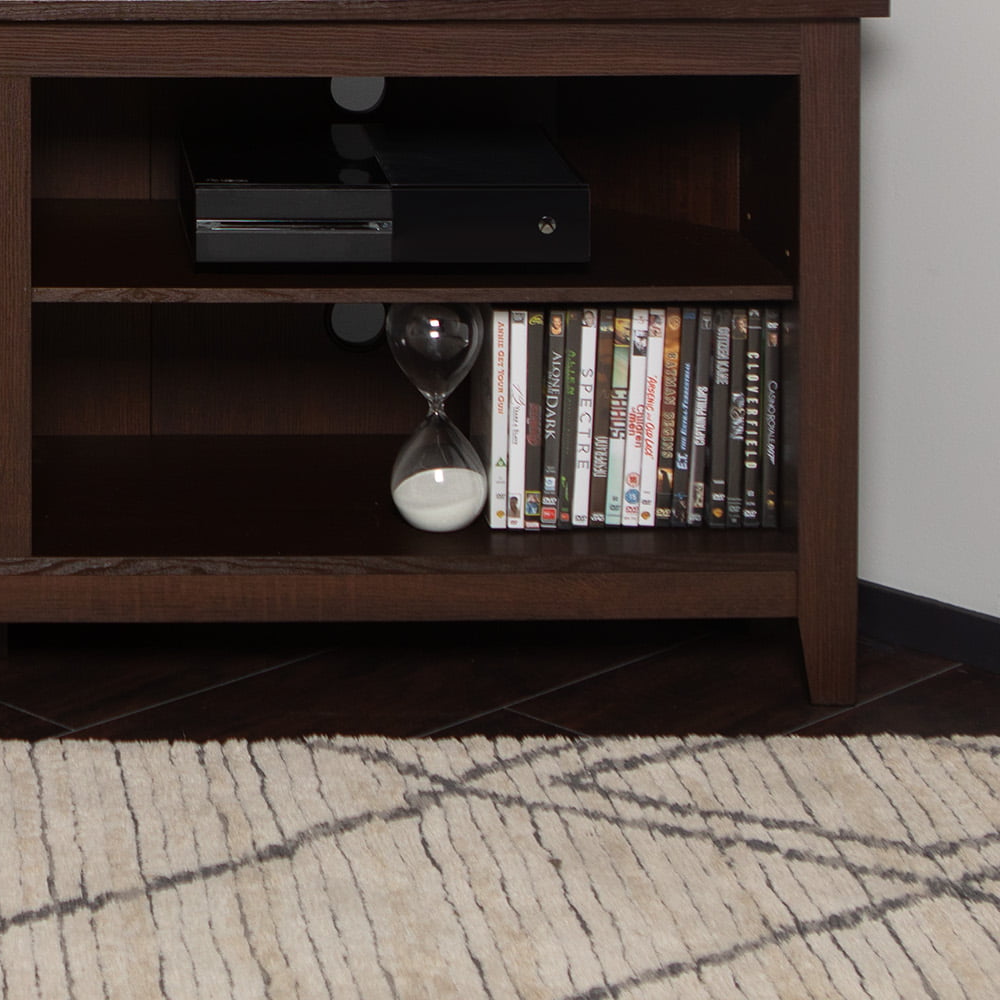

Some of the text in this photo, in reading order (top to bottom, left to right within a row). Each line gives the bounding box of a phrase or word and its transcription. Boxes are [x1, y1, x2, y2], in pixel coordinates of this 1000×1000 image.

[497, 321, 505, 415] ANNIE GET YOUR GUN
[552, 351, 563, 394] ALONE
[715, 326, 730, 385] CITIZEN KANE
[545, 395, 558, 439] DARK
[577, 368, 594, 469] SPECTRE
[660, 352, 678, 459] BATMAN BEGINS
[694, 386, 709, 446] CAPTAIN PHILLIPS
[744, 352, 760, 469] CLOVERFIELD
[767, 380, 778, 414] CASINO
[767, 414, 777, 444] ROYALE
